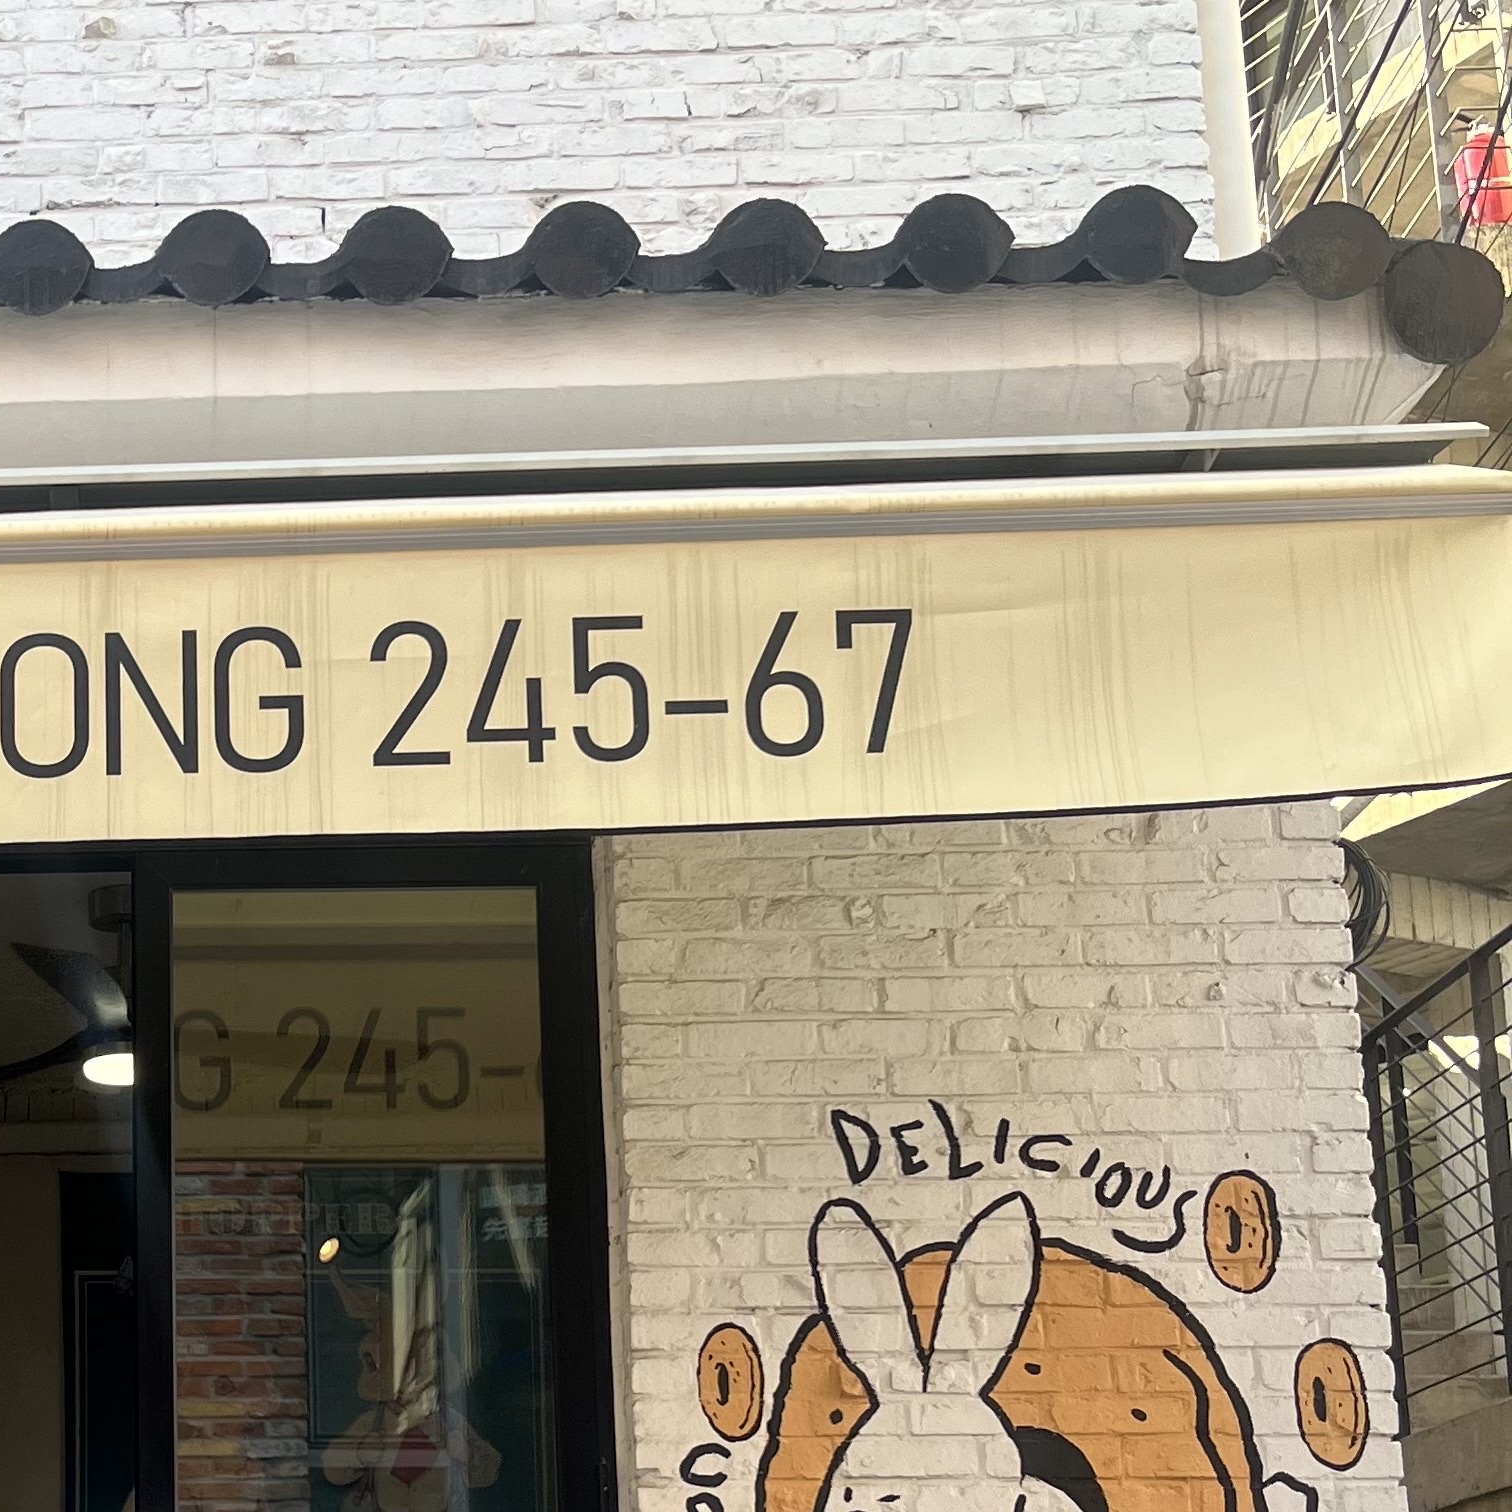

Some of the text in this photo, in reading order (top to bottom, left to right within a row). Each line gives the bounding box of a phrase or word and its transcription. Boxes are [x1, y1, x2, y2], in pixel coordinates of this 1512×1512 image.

[369, 608, 913, 767] 245-67
[277, 1006, 541, 1112] 245-
[830, 1098, 1198, 1254] DELICIOUS
